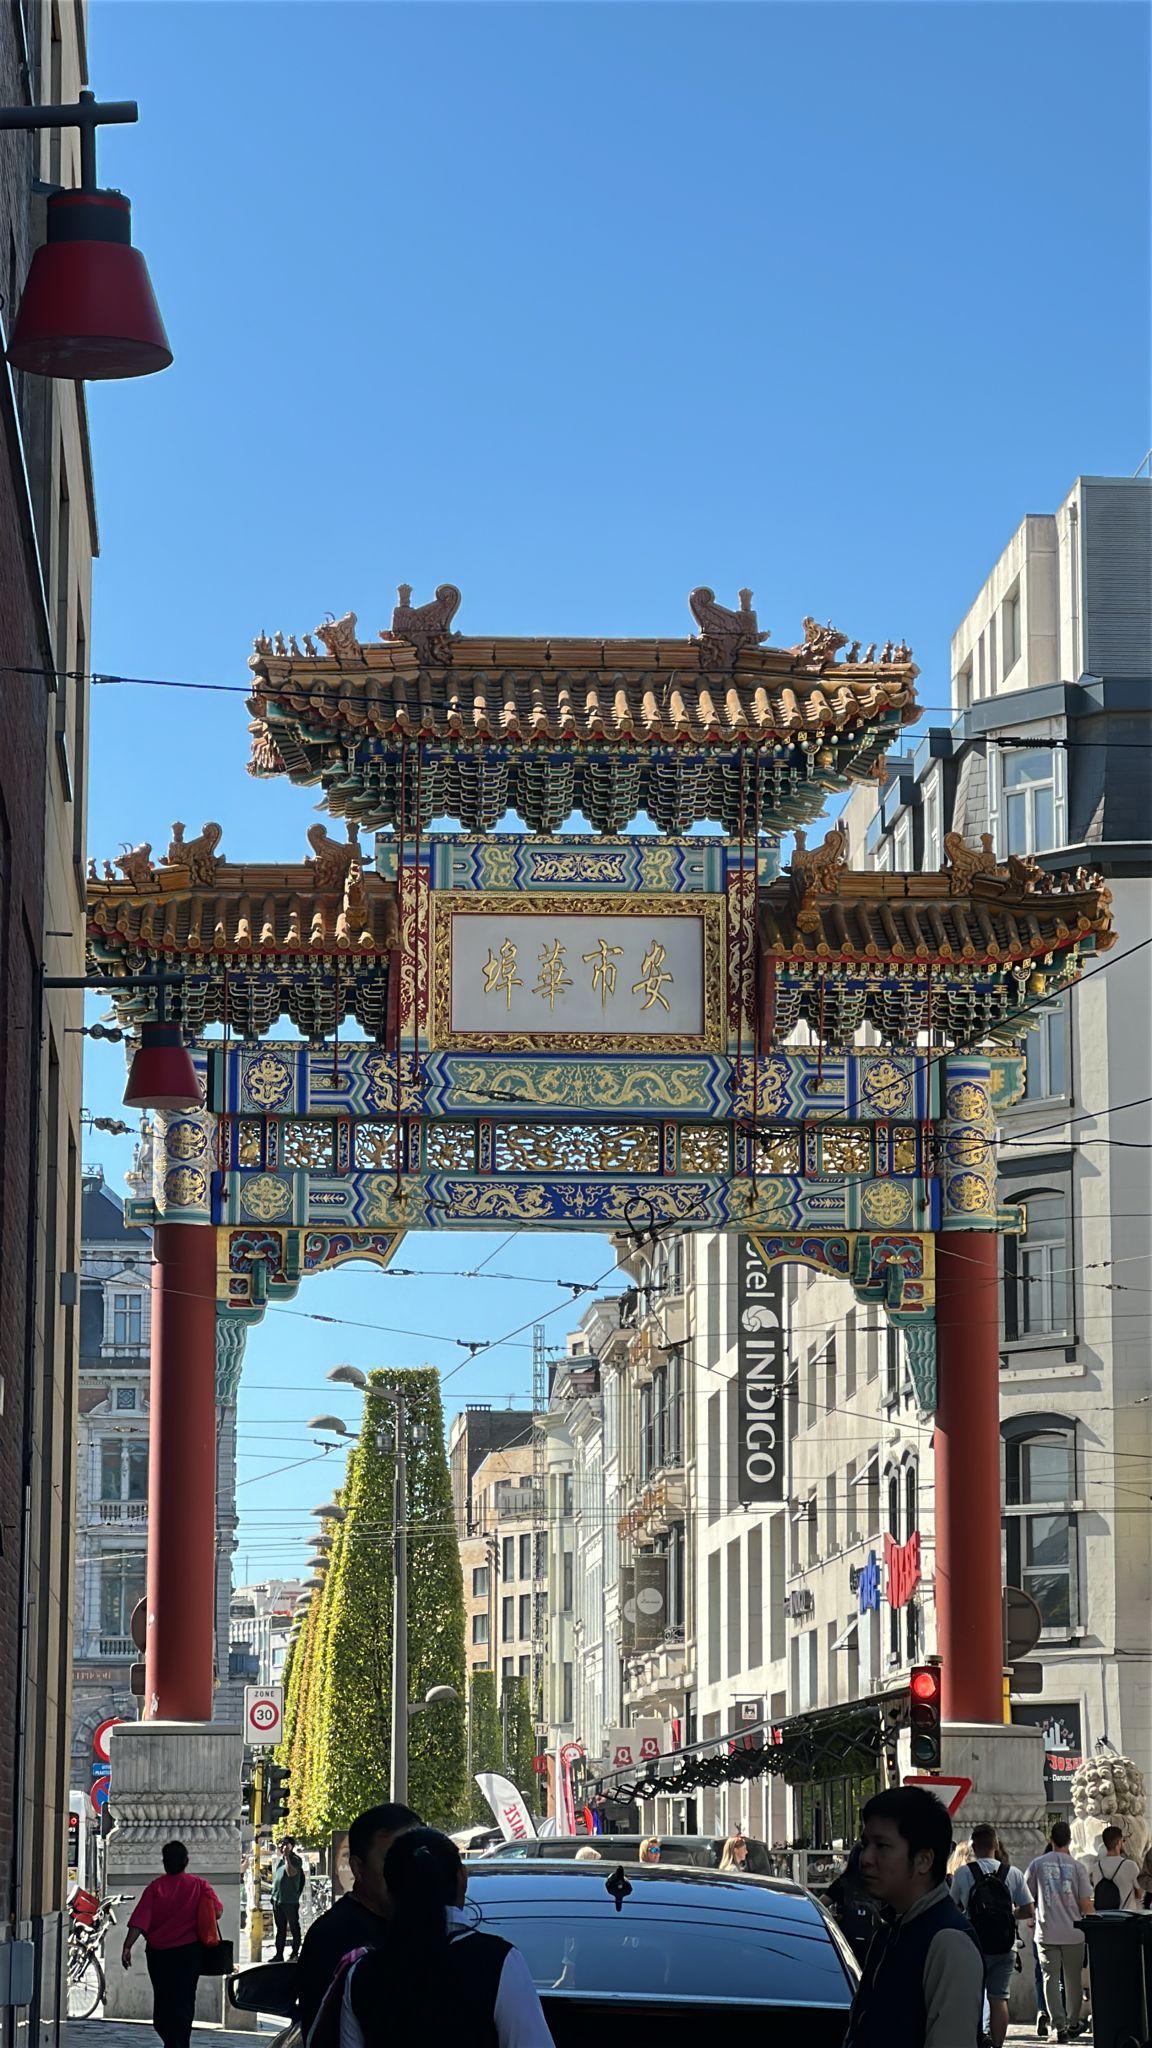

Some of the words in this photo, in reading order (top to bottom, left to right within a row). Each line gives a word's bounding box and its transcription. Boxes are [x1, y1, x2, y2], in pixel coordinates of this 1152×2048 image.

[746, 1340, 776, 1483] INDIGO
[254, 1690, 274, 1698] ZONE
[256, 1709, 273, 1721] 30
[644, 1740, 657, 1755] Q
